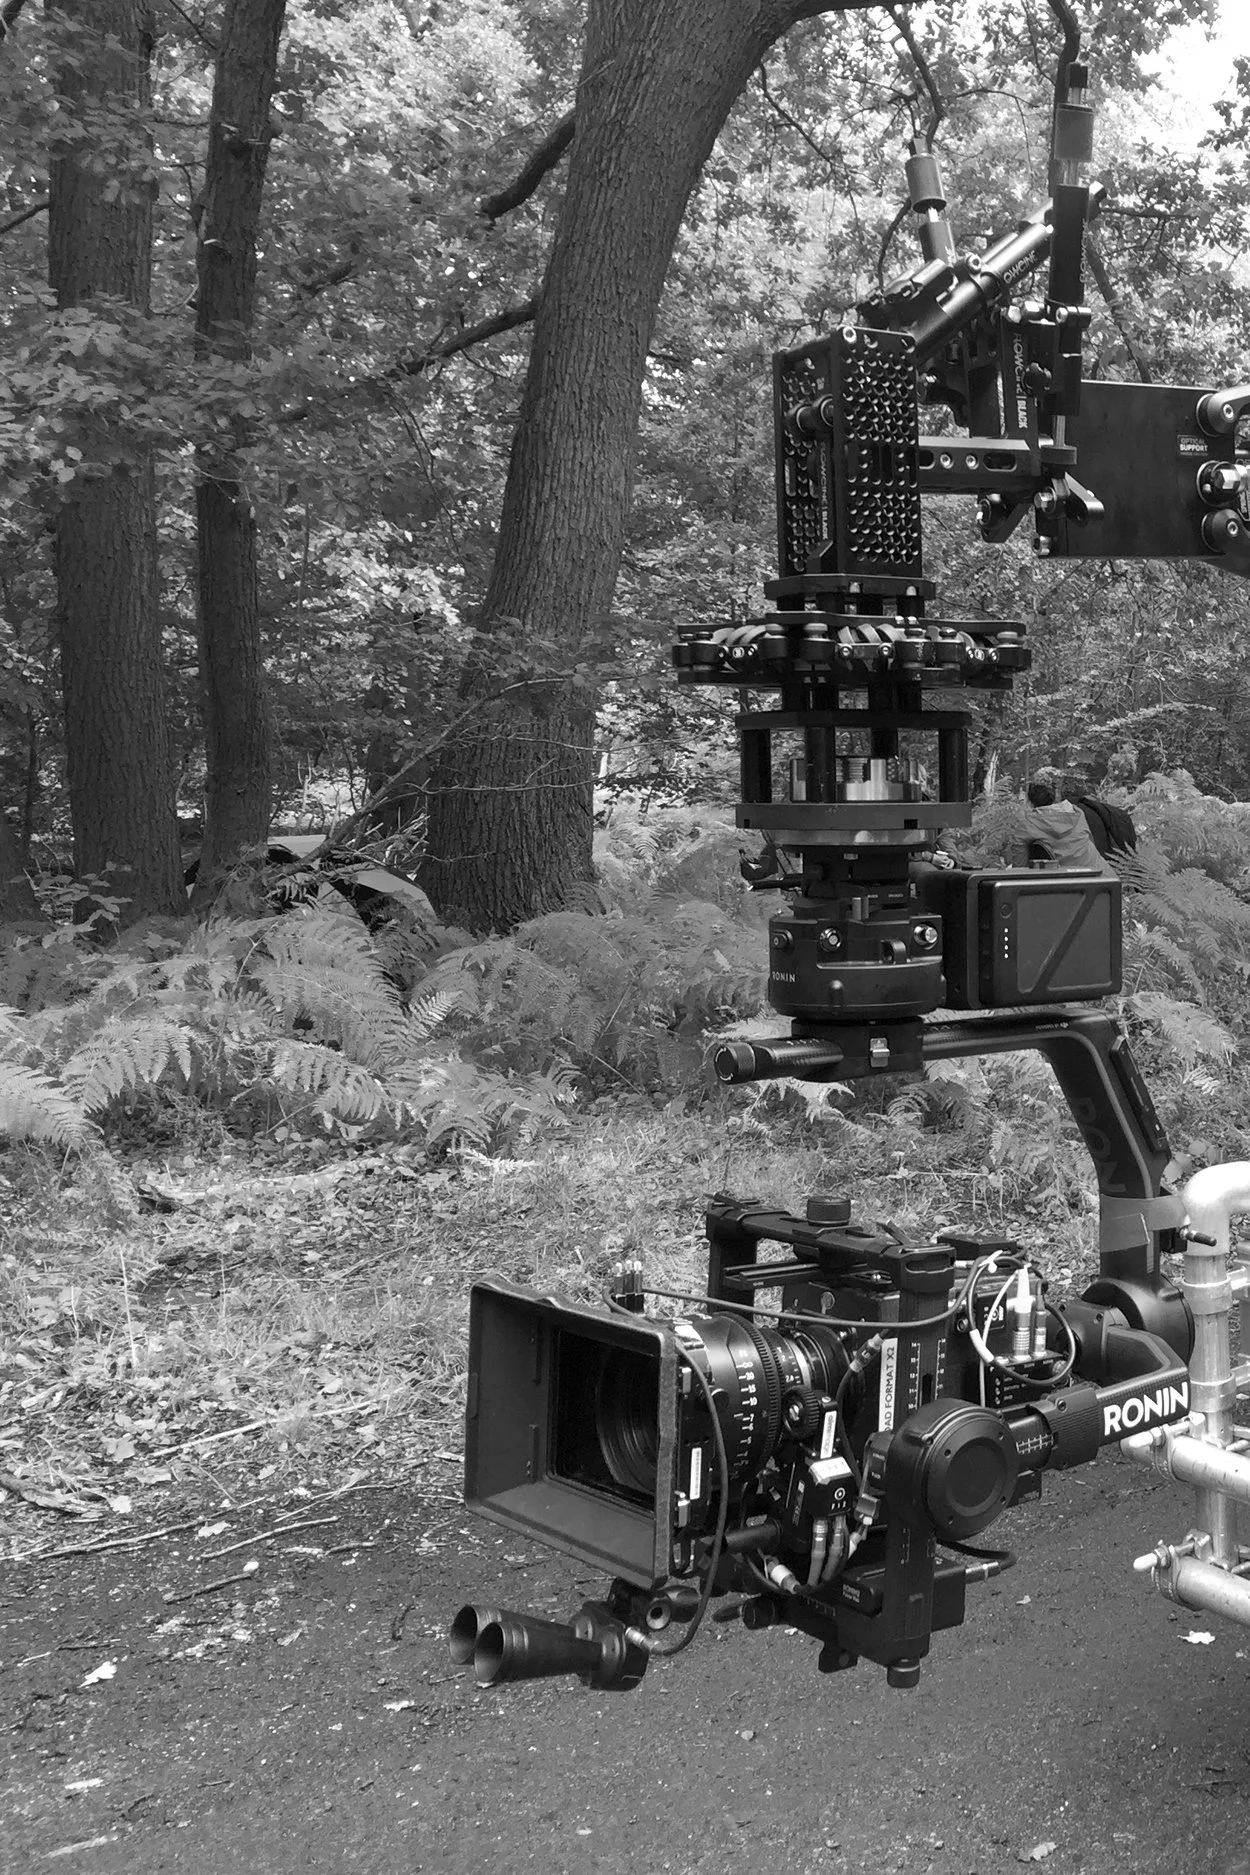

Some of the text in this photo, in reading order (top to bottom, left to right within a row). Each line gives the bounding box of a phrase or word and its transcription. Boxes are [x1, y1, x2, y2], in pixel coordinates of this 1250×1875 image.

[1017, 400, 1028, 429] BLACK
[1180, 444, 1208, 452] SUPPORT
[886, 1346, 895, 1361] X2
[748, 1384, 757, 1393] 15
[885, 1364, 894, 1410] FORMAT
[750, 1397, 758, 1406] 10
[1103, 1381, 1189, 1437] RONIN
